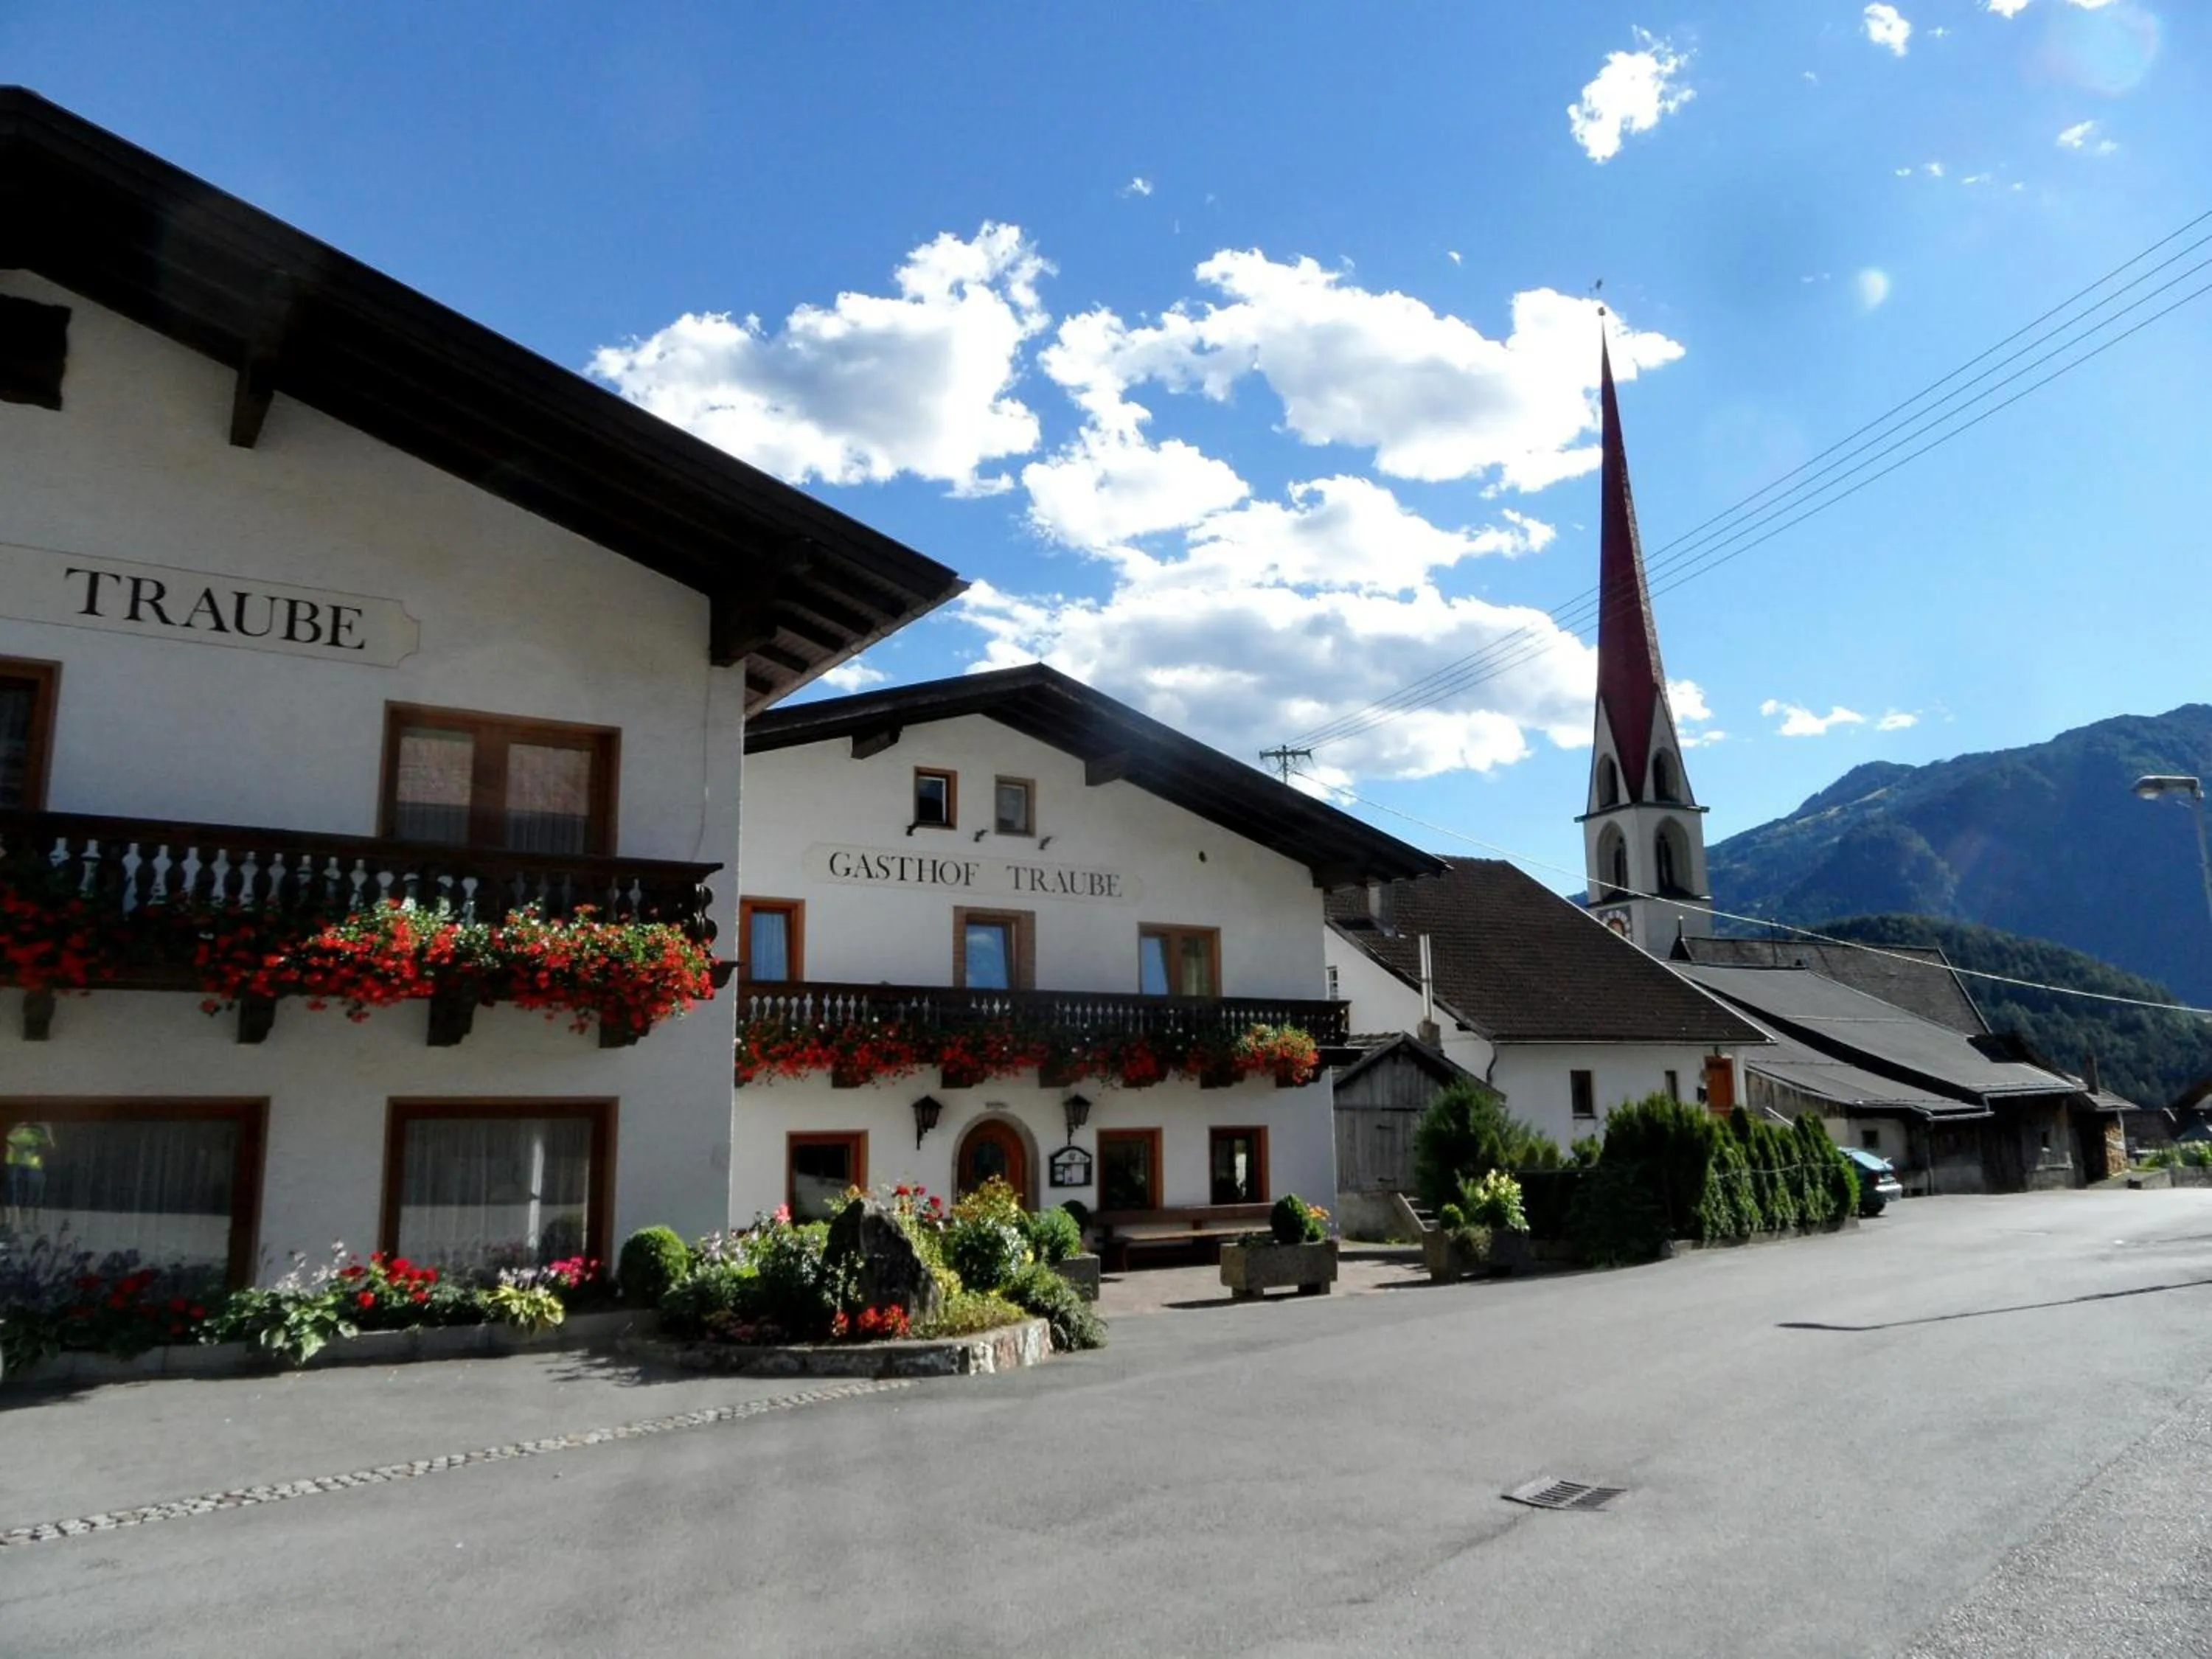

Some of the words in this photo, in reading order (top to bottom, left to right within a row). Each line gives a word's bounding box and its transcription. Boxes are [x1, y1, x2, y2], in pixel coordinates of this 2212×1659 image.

[65, 567, 366, 650] TRAUBE
[829, 852, 980, 886] GASTHOF
[1006, 865, 1123, 897] TRAUBE
